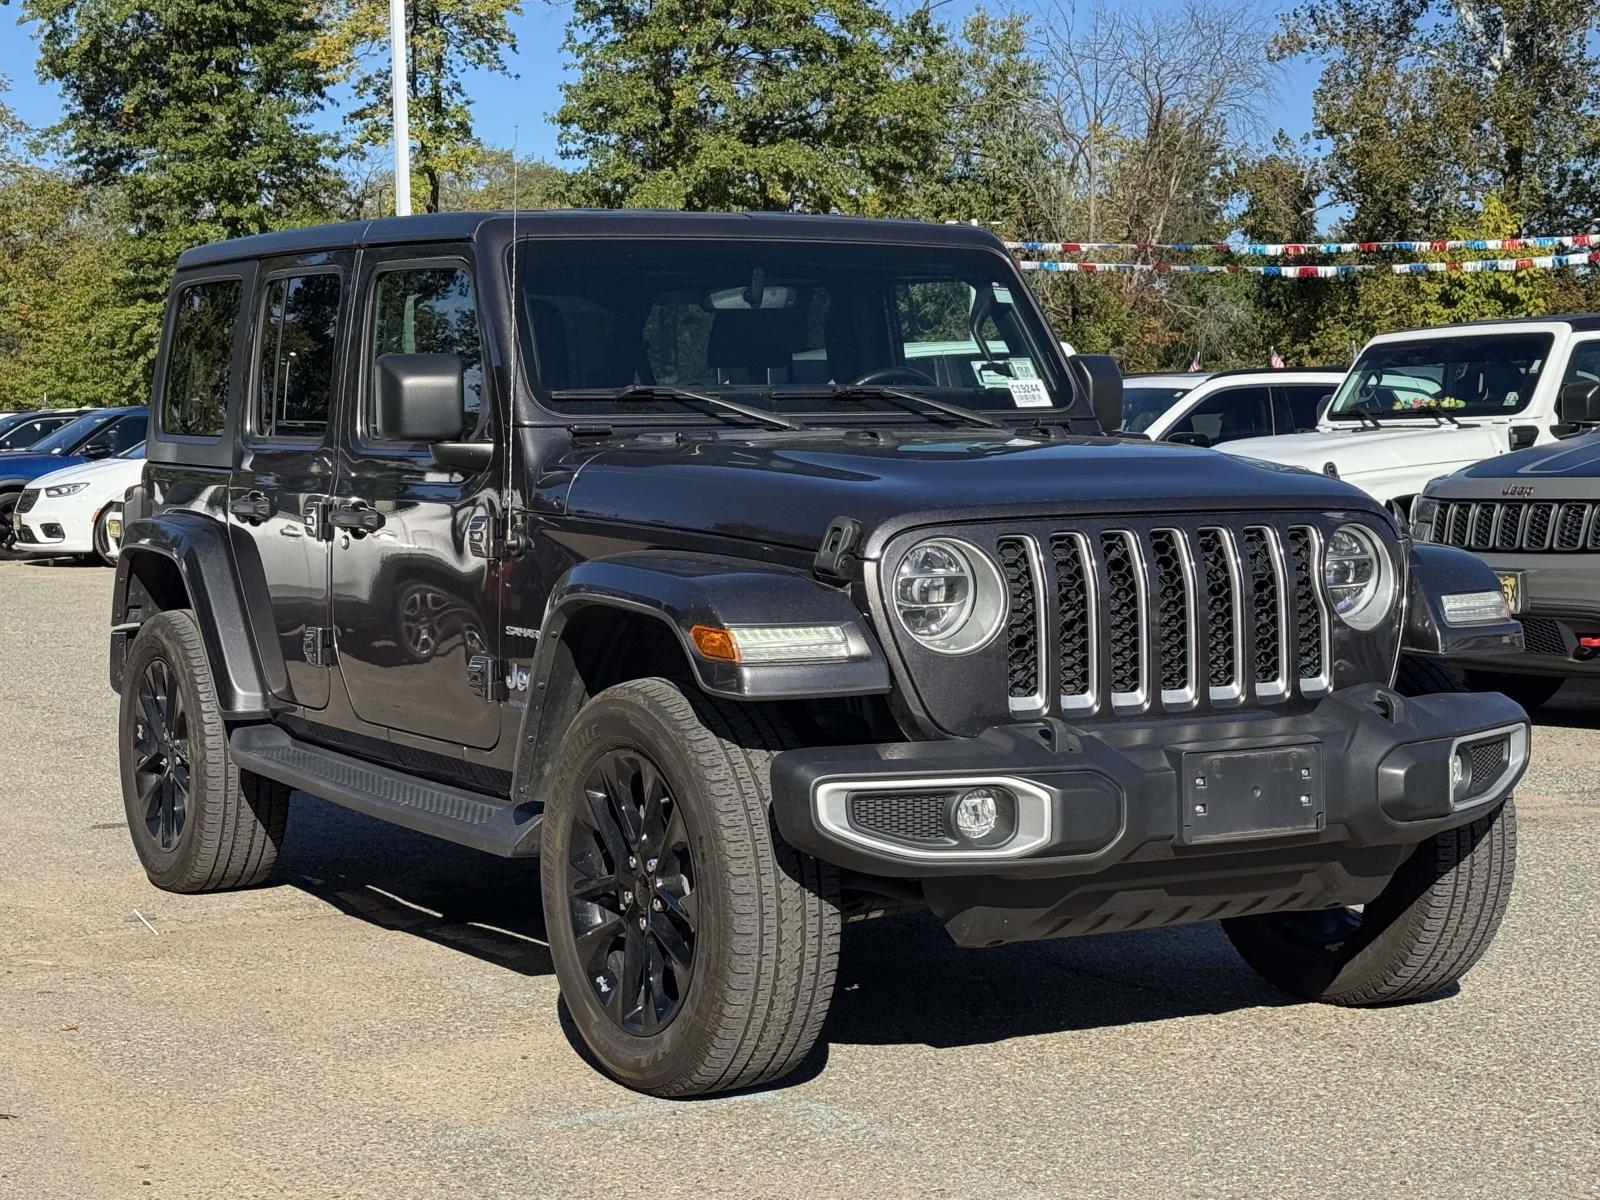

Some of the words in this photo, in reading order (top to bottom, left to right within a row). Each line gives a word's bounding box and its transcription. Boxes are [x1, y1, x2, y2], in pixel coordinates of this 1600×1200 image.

[1011, 383, 1041, 394] C19244
[1502, 483, 1535, 499] Jeep
[505, 625, 541, 640] SAHAR
[506, 663, 530, 692] Je
